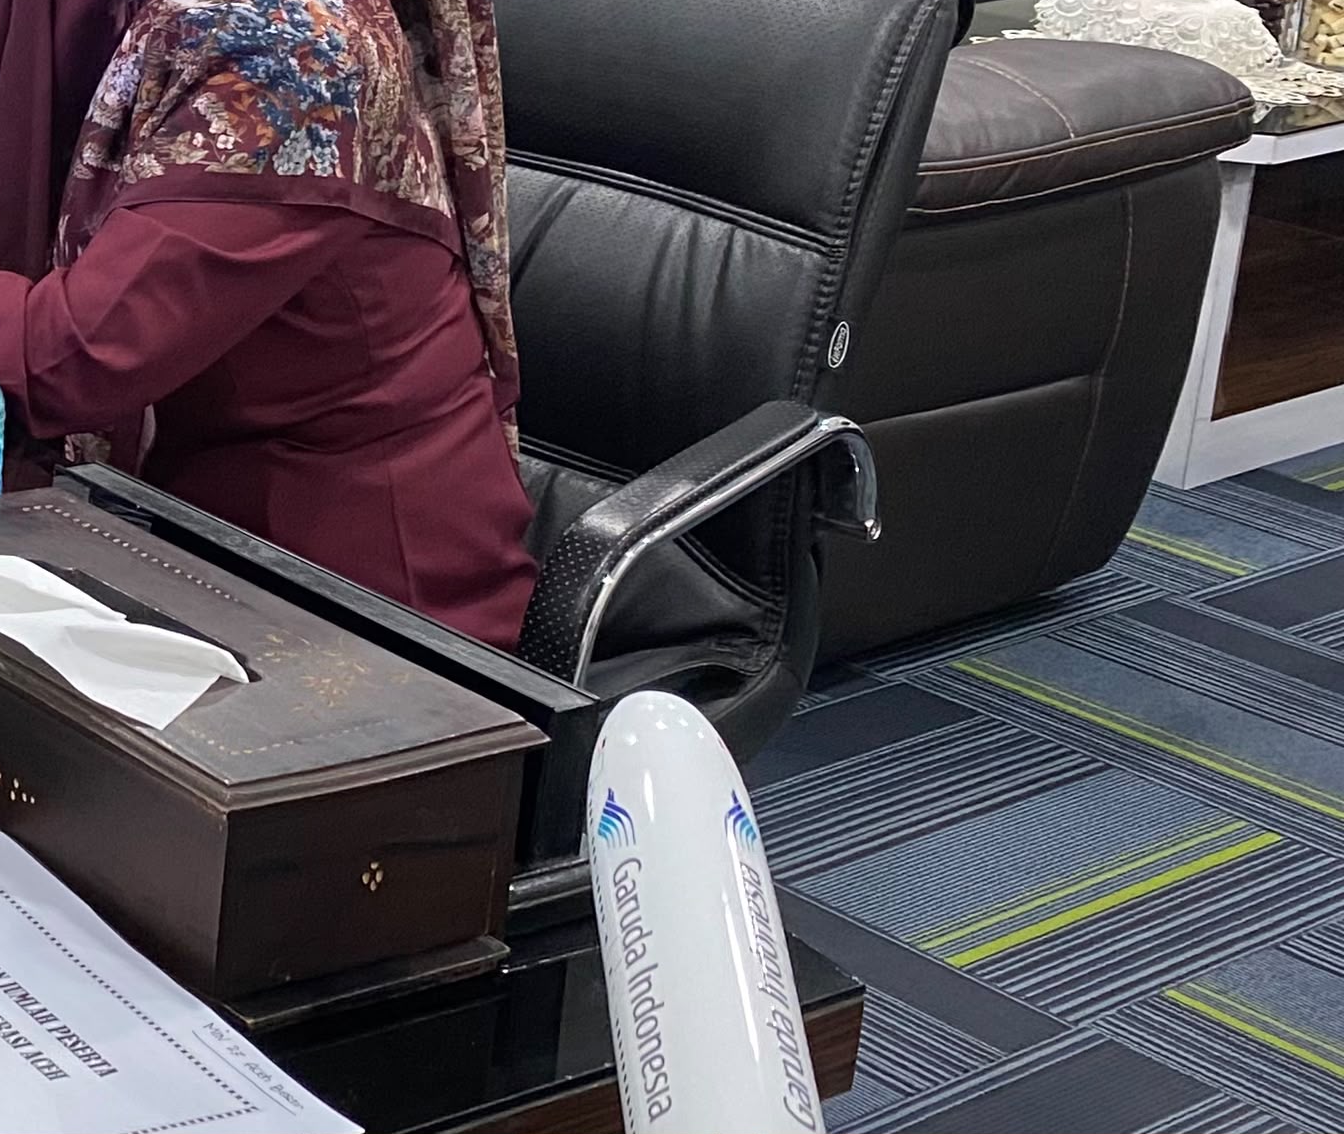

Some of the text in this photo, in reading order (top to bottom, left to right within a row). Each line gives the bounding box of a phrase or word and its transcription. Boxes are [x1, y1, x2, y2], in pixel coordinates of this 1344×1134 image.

[20, 1050, 71, 1081] ACEH
[46, 1024, 119, 1078] PESERTA
[613, 857, 673, 1124] Garuda Indonesia
[740, 862, 817, 1133] Garuda Indonesia
